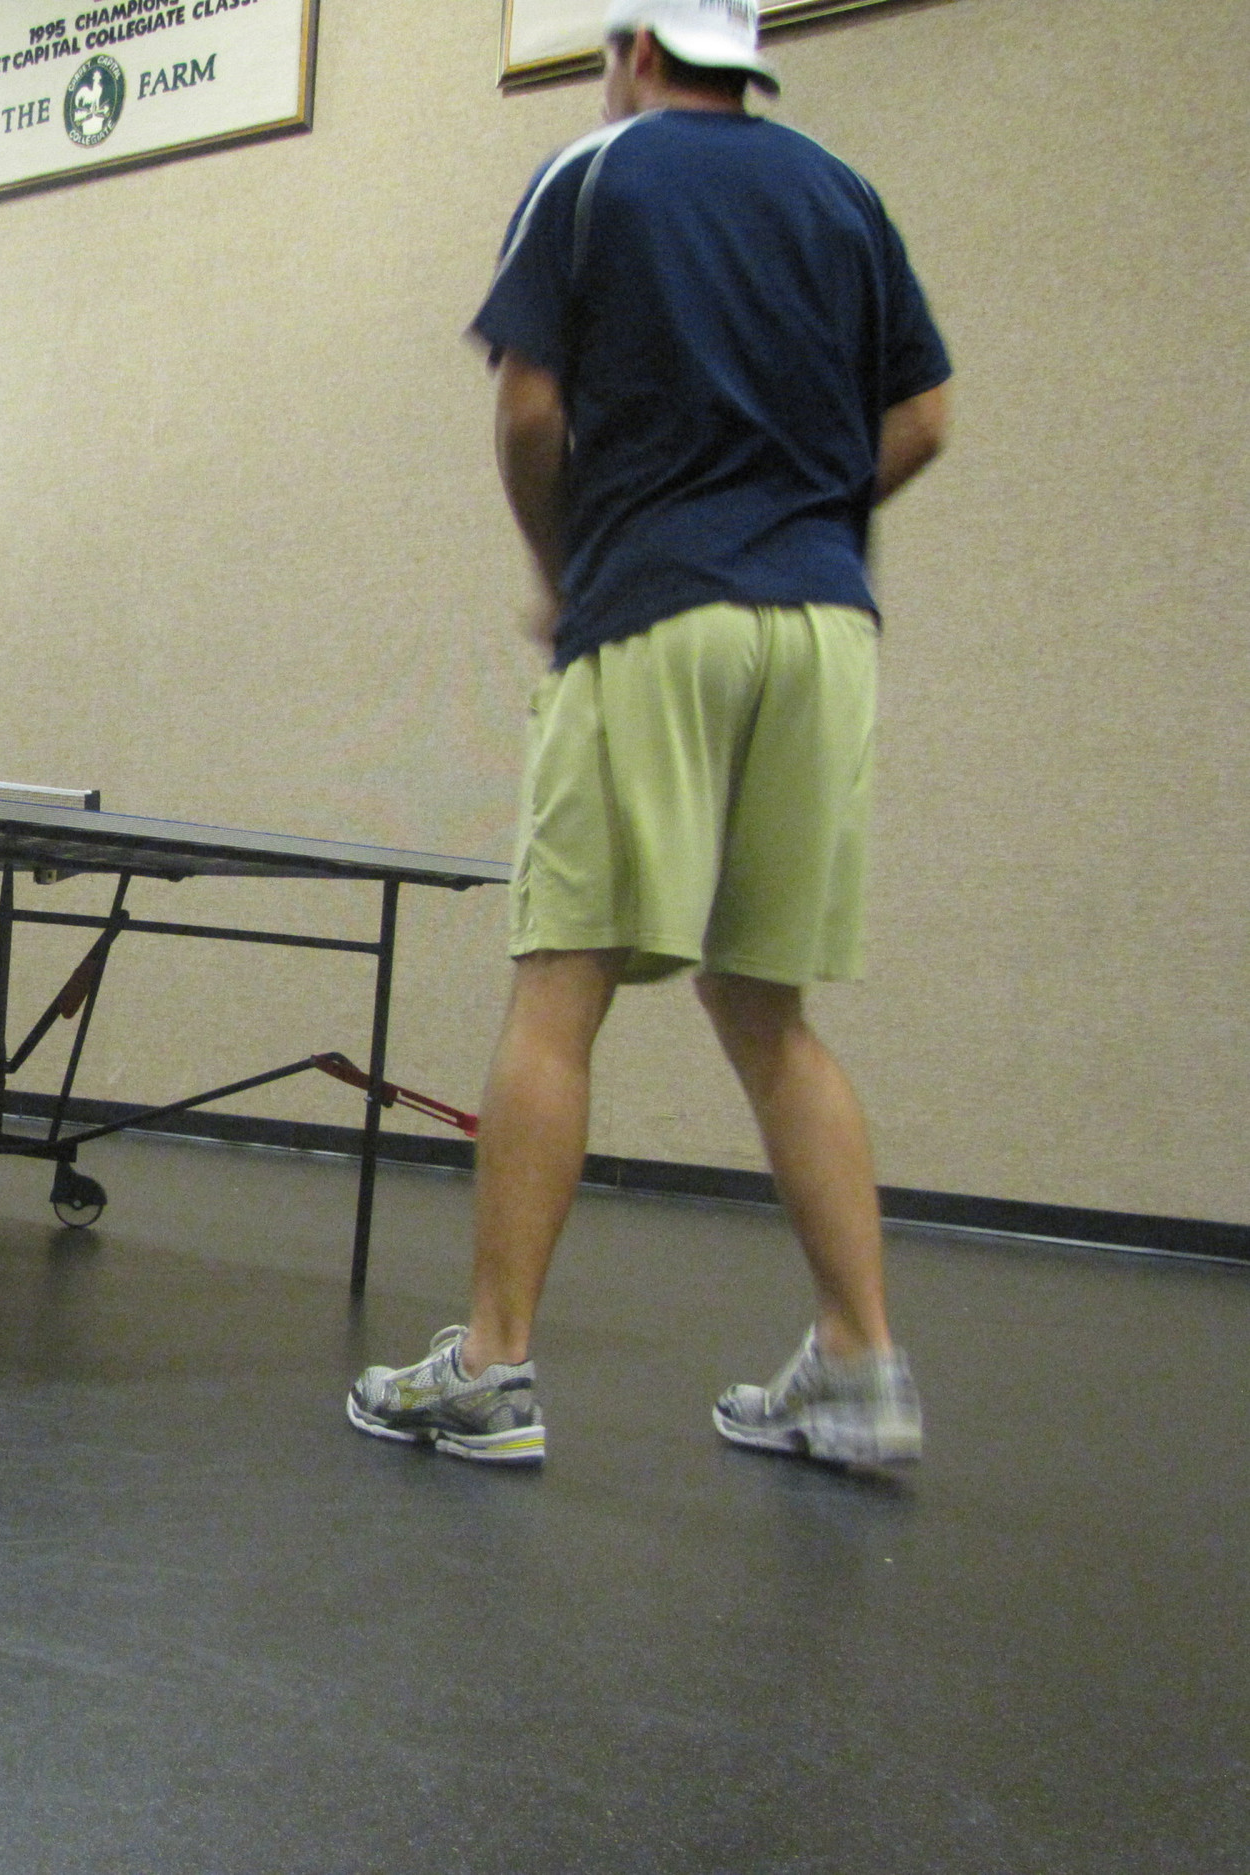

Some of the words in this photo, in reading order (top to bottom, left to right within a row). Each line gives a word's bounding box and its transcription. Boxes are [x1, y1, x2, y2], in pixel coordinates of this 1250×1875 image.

[13, 36, 81, 71] CAPITAL
[85, 5, 185, 49] COLLEGIATE
[29, 19, 65, 46] 1995
[2, 97, 51, 133] THE
[137, 53, 217, 100] FARM
